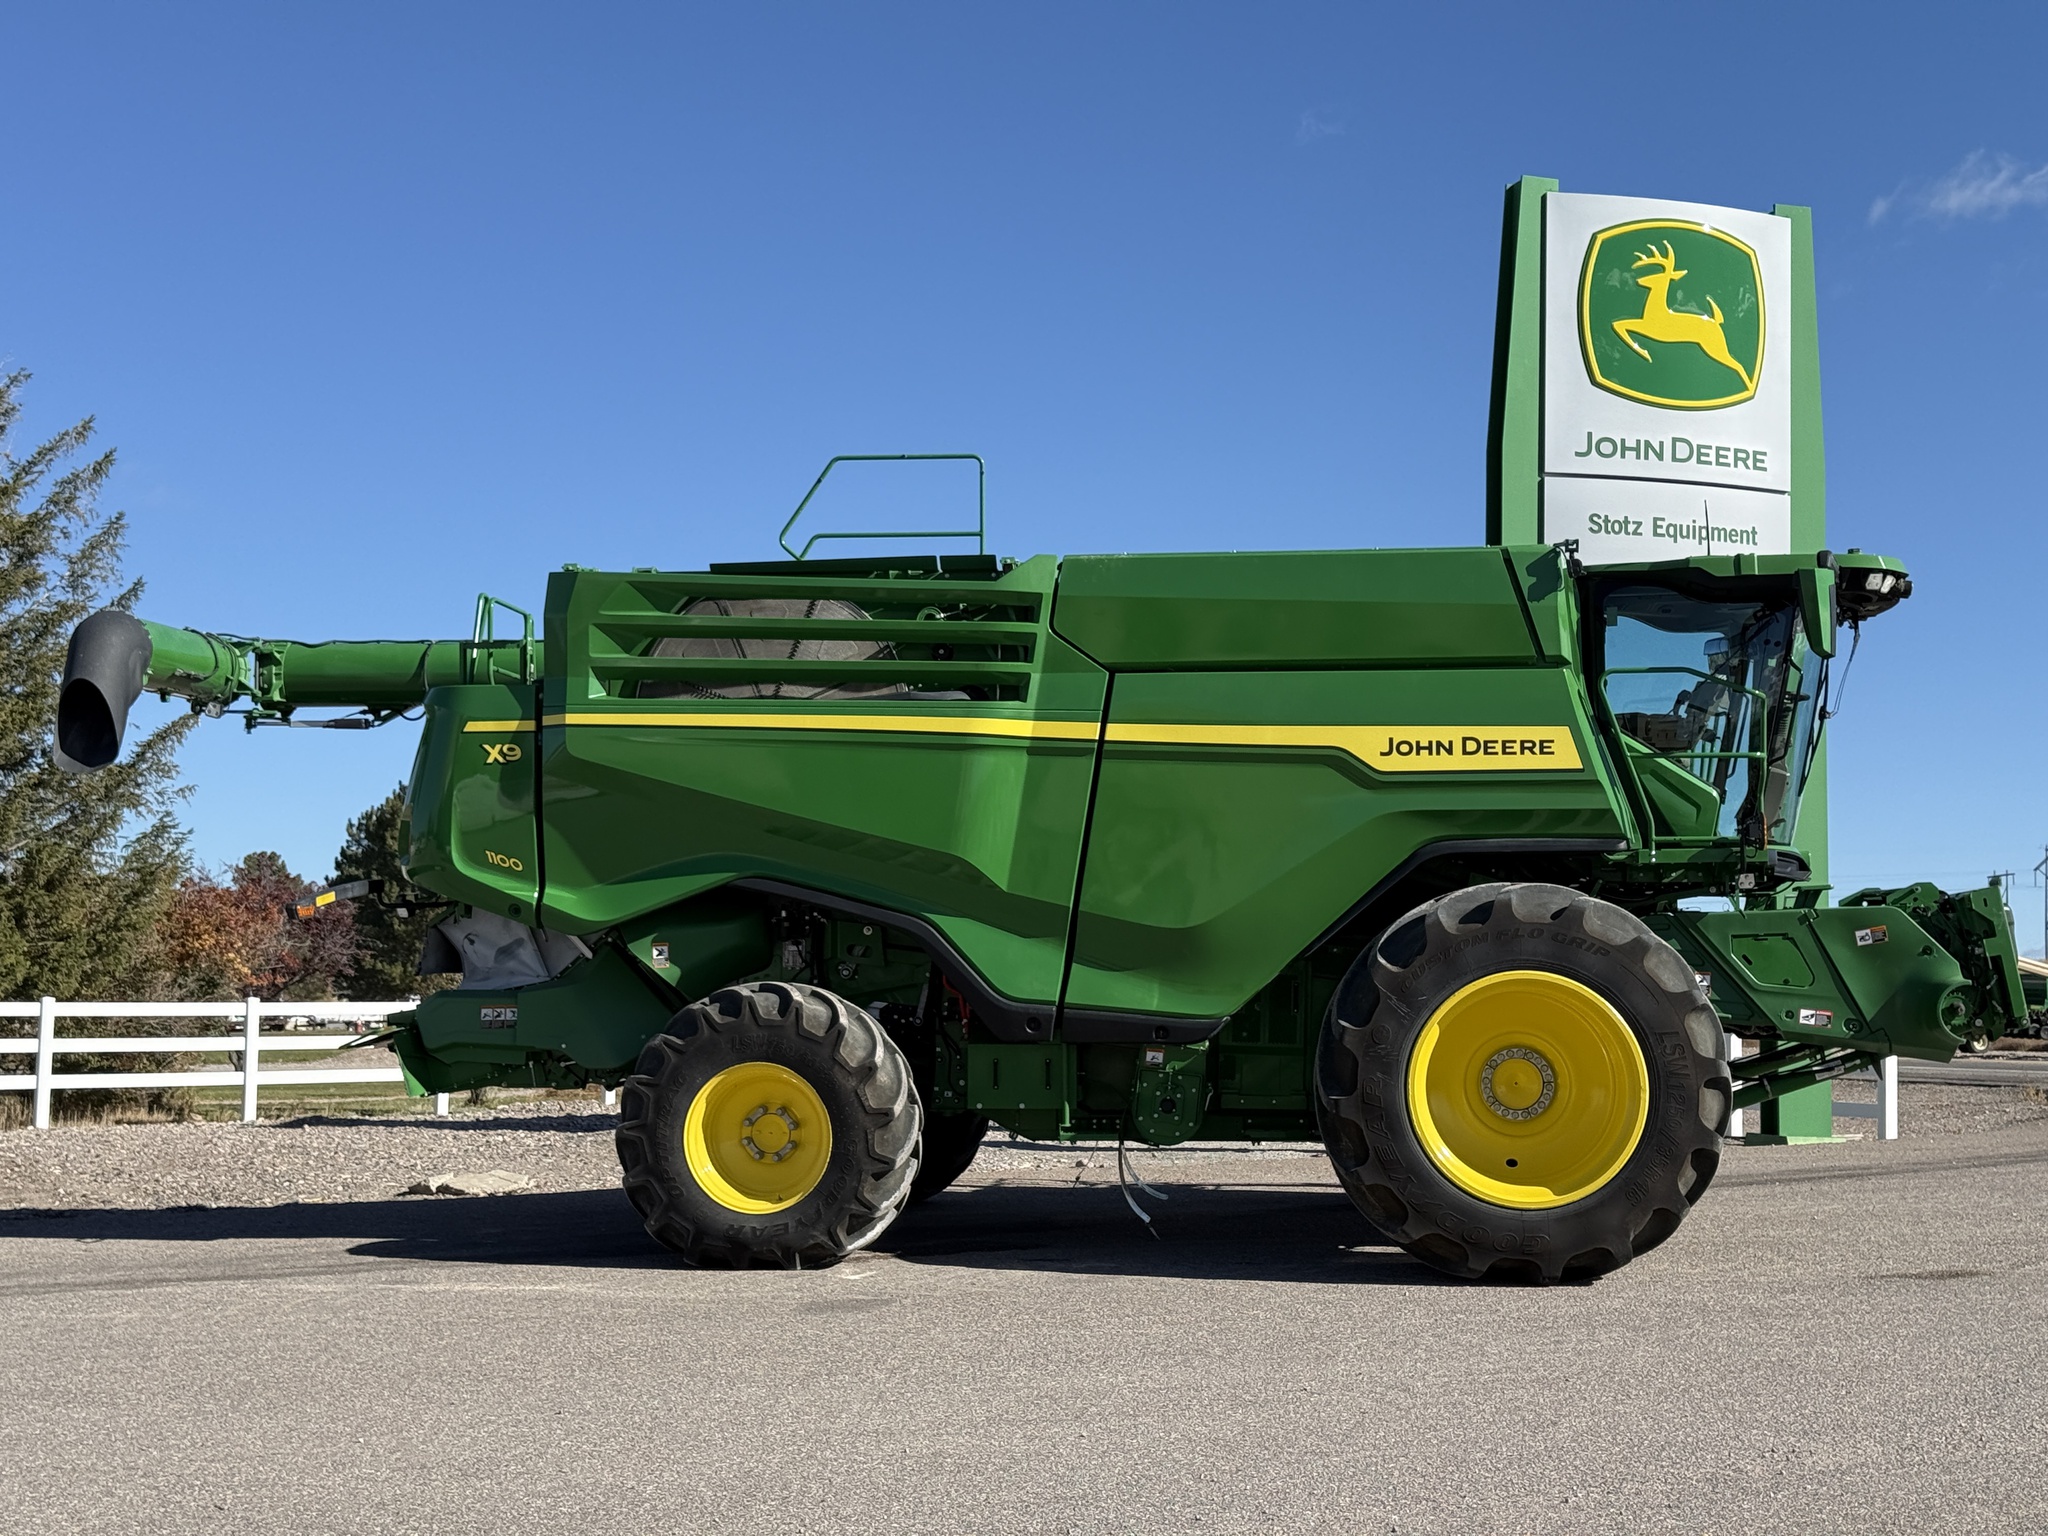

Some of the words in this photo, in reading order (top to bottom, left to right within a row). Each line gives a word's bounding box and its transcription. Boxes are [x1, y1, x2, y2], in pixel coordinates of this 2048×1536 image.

[1574, 431, 1664, 462] JOHN
[1671, 436, 1768, 472] DEERE
[1587, 512, 1643, 537] Stotz
[1652, 516, 1758, 546] Equipment
[481, 743, 522, 764] X9
[1379, 736, 1453, 757] JOHN
[1461, 736, 1555, 756] DEERE
[485, 850, 524, 872] 1100
[1495, 926, 1545, 941] FLO
[1550, 931, 1612, 958] GRIP
